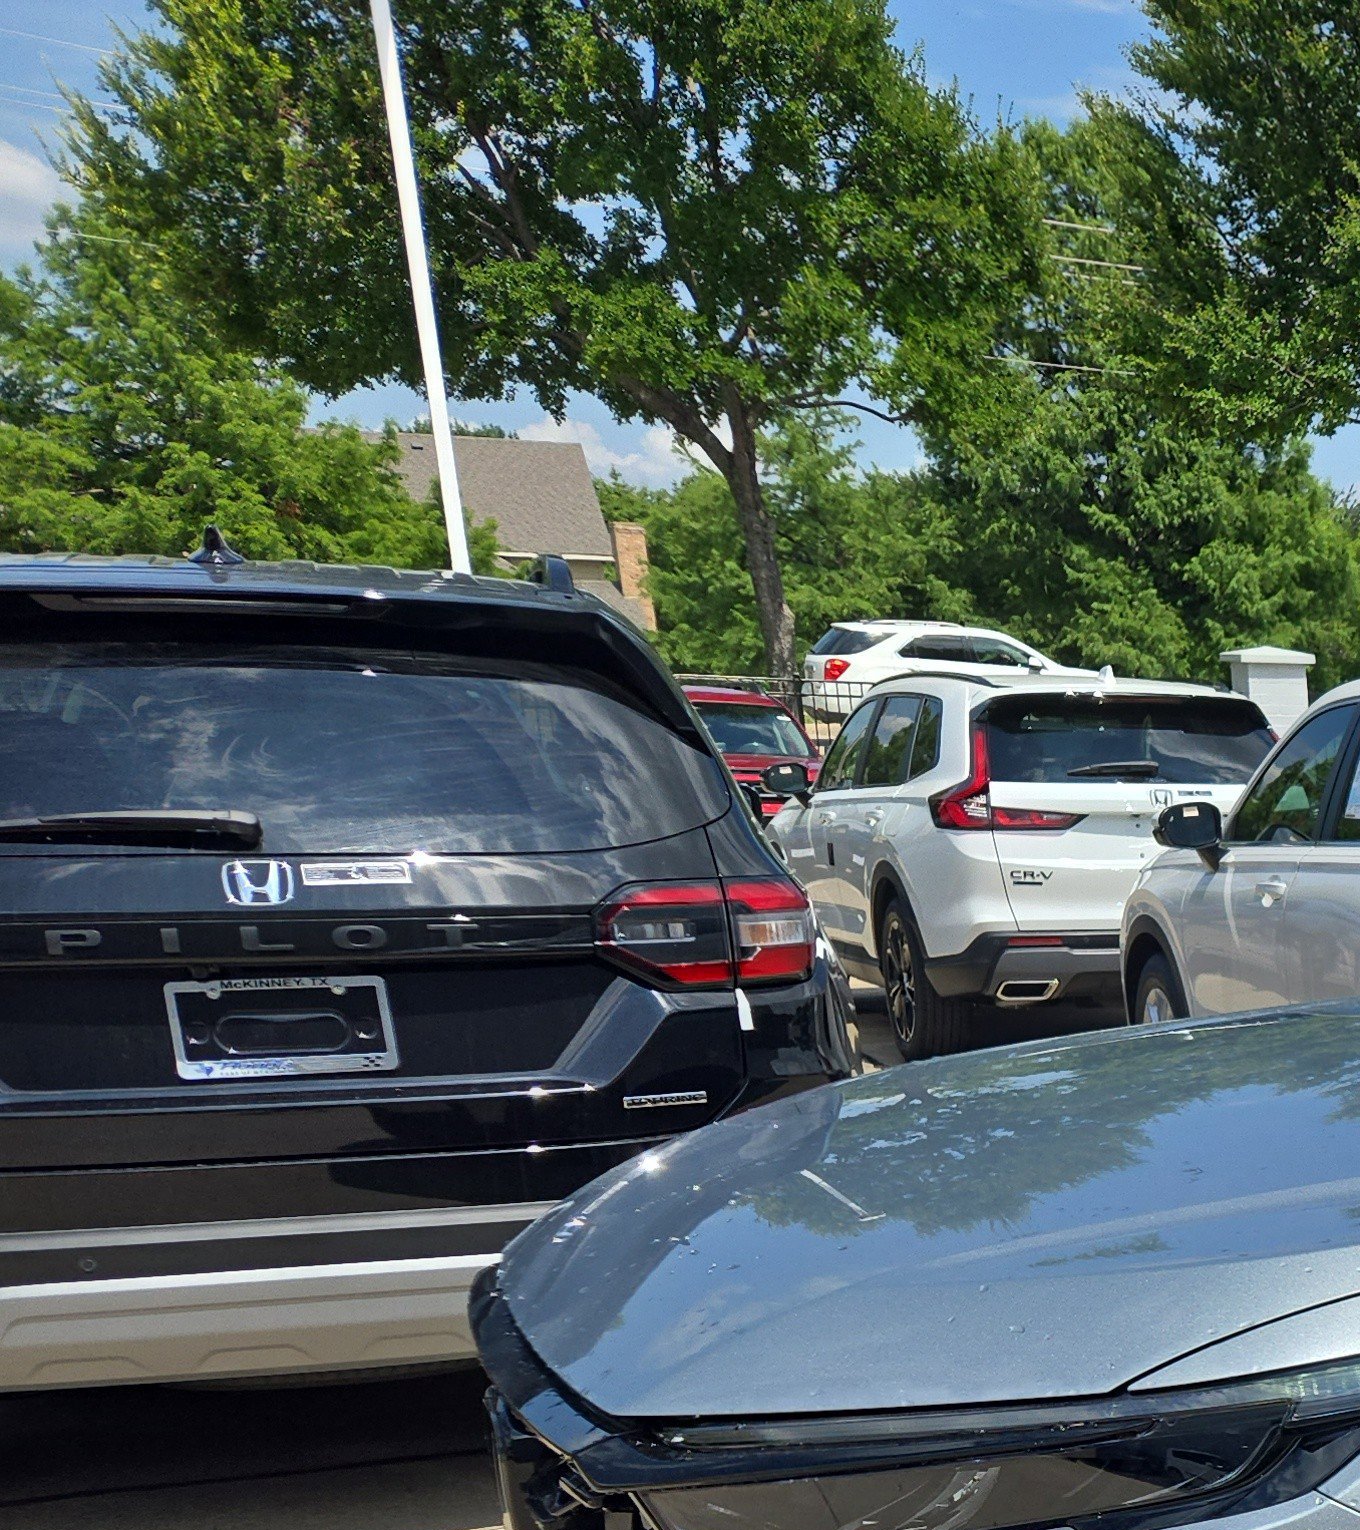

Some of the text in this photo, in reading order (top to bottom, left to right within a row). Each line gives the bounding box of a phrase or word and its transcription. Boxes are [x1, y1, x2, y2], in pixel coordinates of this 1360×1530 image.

[1010, 870, 1053, 880] CR-V
[45, 923, 478, 956] PILOT
[311, 977, 328, 987] TX
